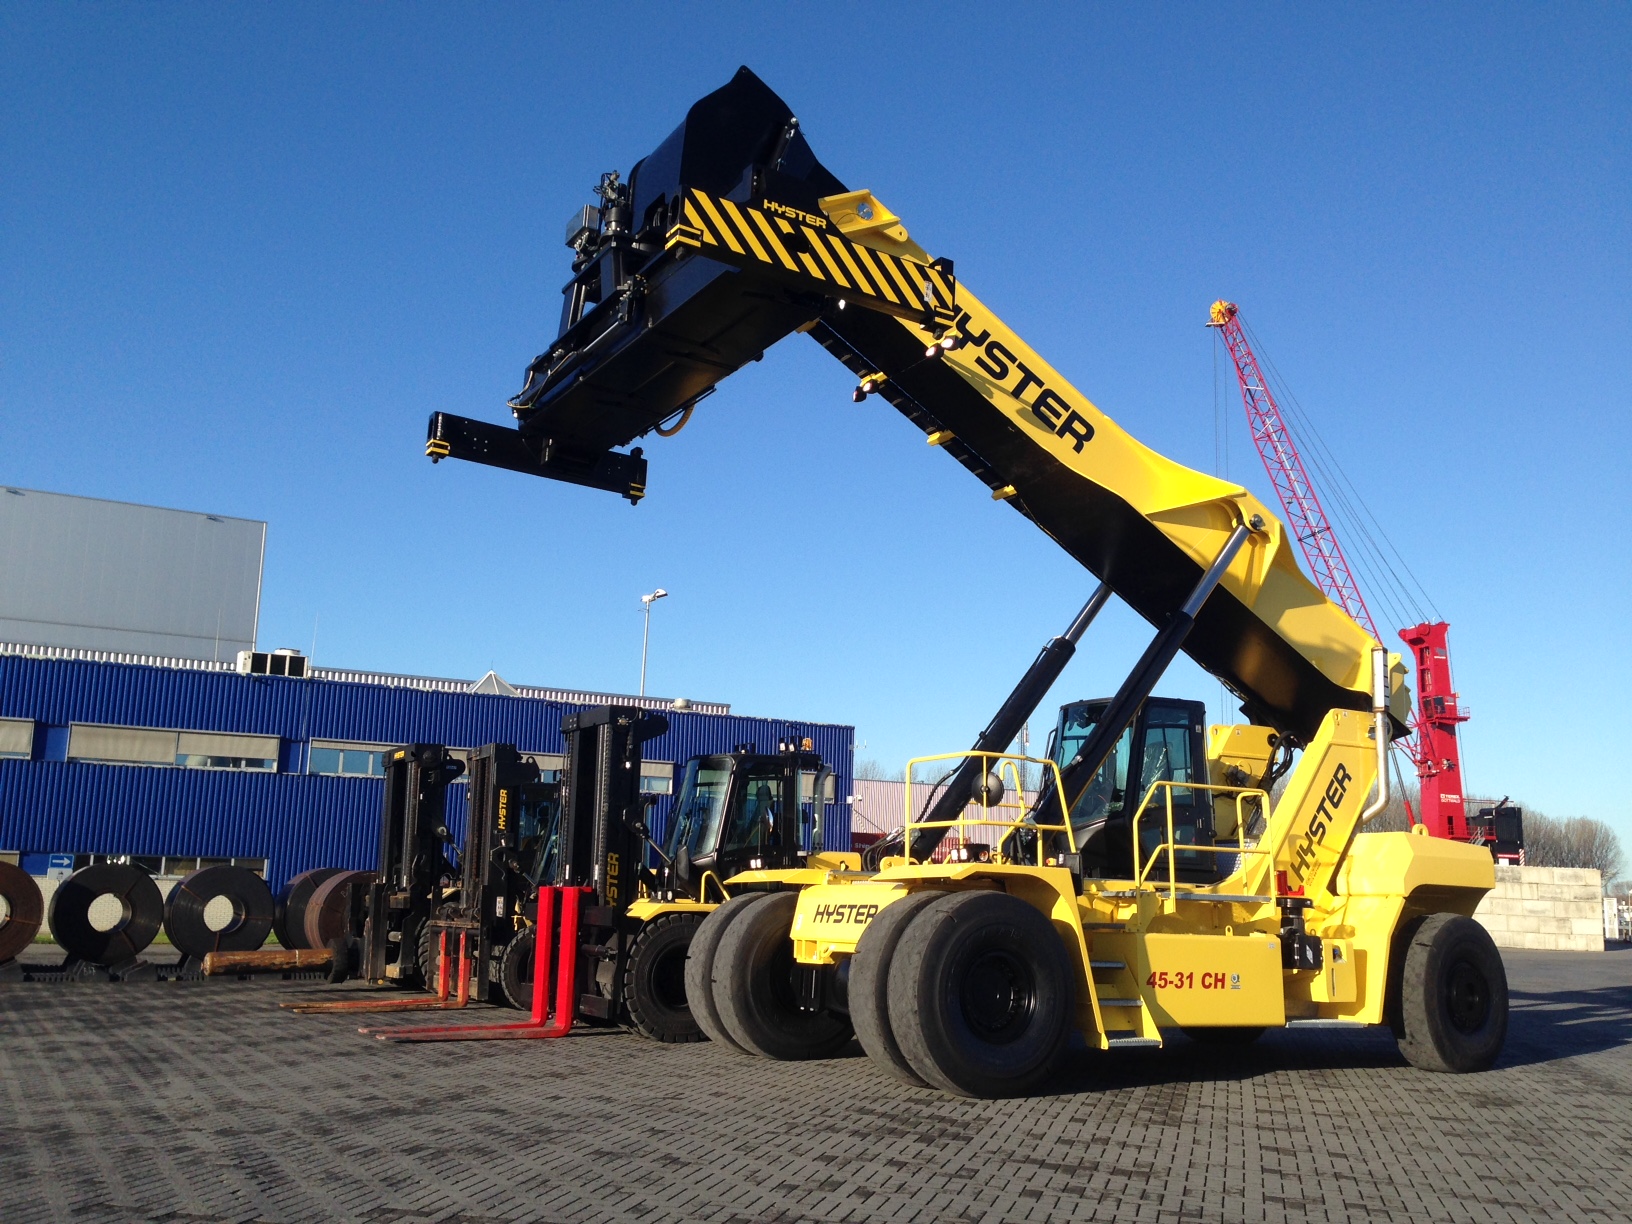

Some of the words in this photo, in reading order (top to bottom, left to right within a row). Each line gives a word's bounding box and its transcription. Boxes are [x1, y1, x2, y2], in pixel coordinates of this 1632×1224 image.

[763, 199, 827, 229] HYSTER
[498, 789, 508, 830] HYSTER
[1290, 763, 1352, 883] HYSTER
[606, 852, 620, 908] YSTER
[813, 904, 879, 924] HYSTER
[1146, 971, 1194, 989] 45-31
[1201, 972, 1226, 990] CH
